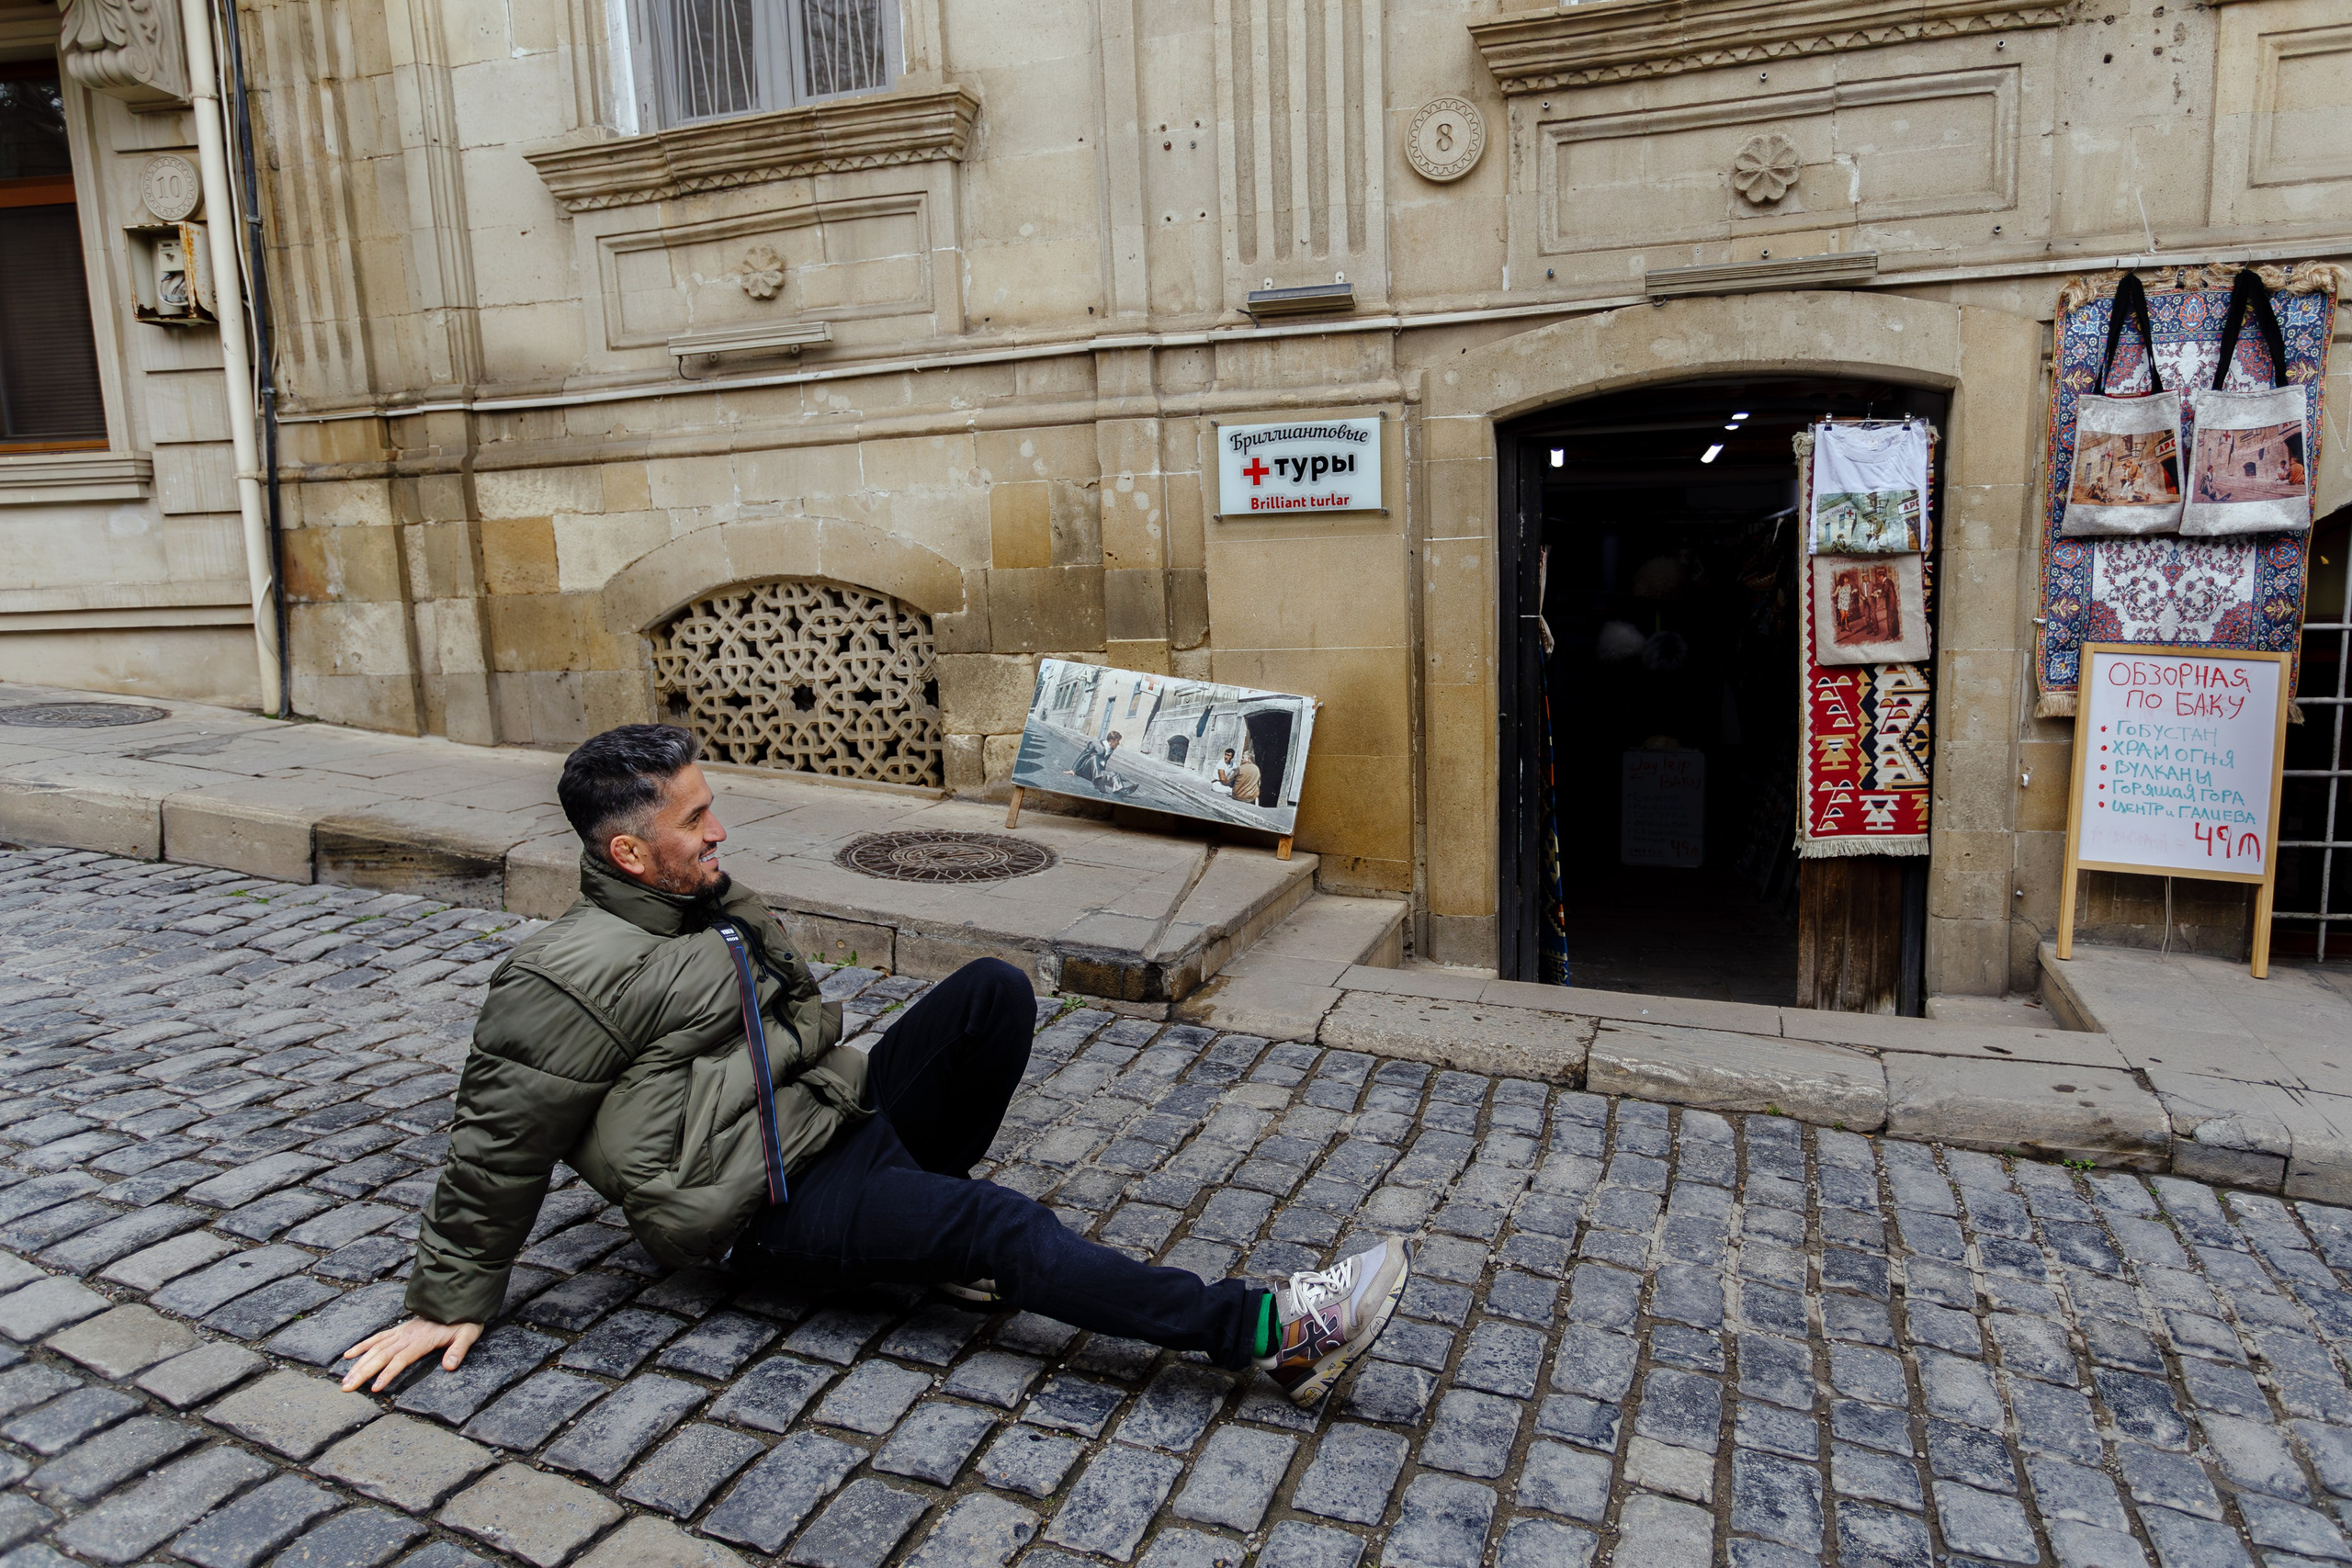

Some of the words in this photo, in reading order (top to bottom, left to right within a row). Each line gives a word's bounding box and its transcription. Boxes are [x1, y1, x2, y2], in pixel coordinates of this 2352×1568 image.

[1436, 123, 1453, 152] 8
[156, 175, 183, 198] 10
[1229, 423, 1368, 456] Бриллиантовые
[1273, 454, 1355, 483] туры
[1250, 496, 1306, 510] Brilliant
[1310, 492, 1350, 507] turlar
[2109, 661, 2251, 694] ОБЗОРНАЯ
[2126, 689, 2163, 709] ПО
[2176, 691, 2245, 720] БАКУ
[2112, 739, 2169, 761] ХРАМ
[2174, 748, 2234, 770] ОГНЯ
[2115, 760, 2212, 787] ВУЛКАНЫ
[2111, 799, 2165, 816] ЦЕНТР
